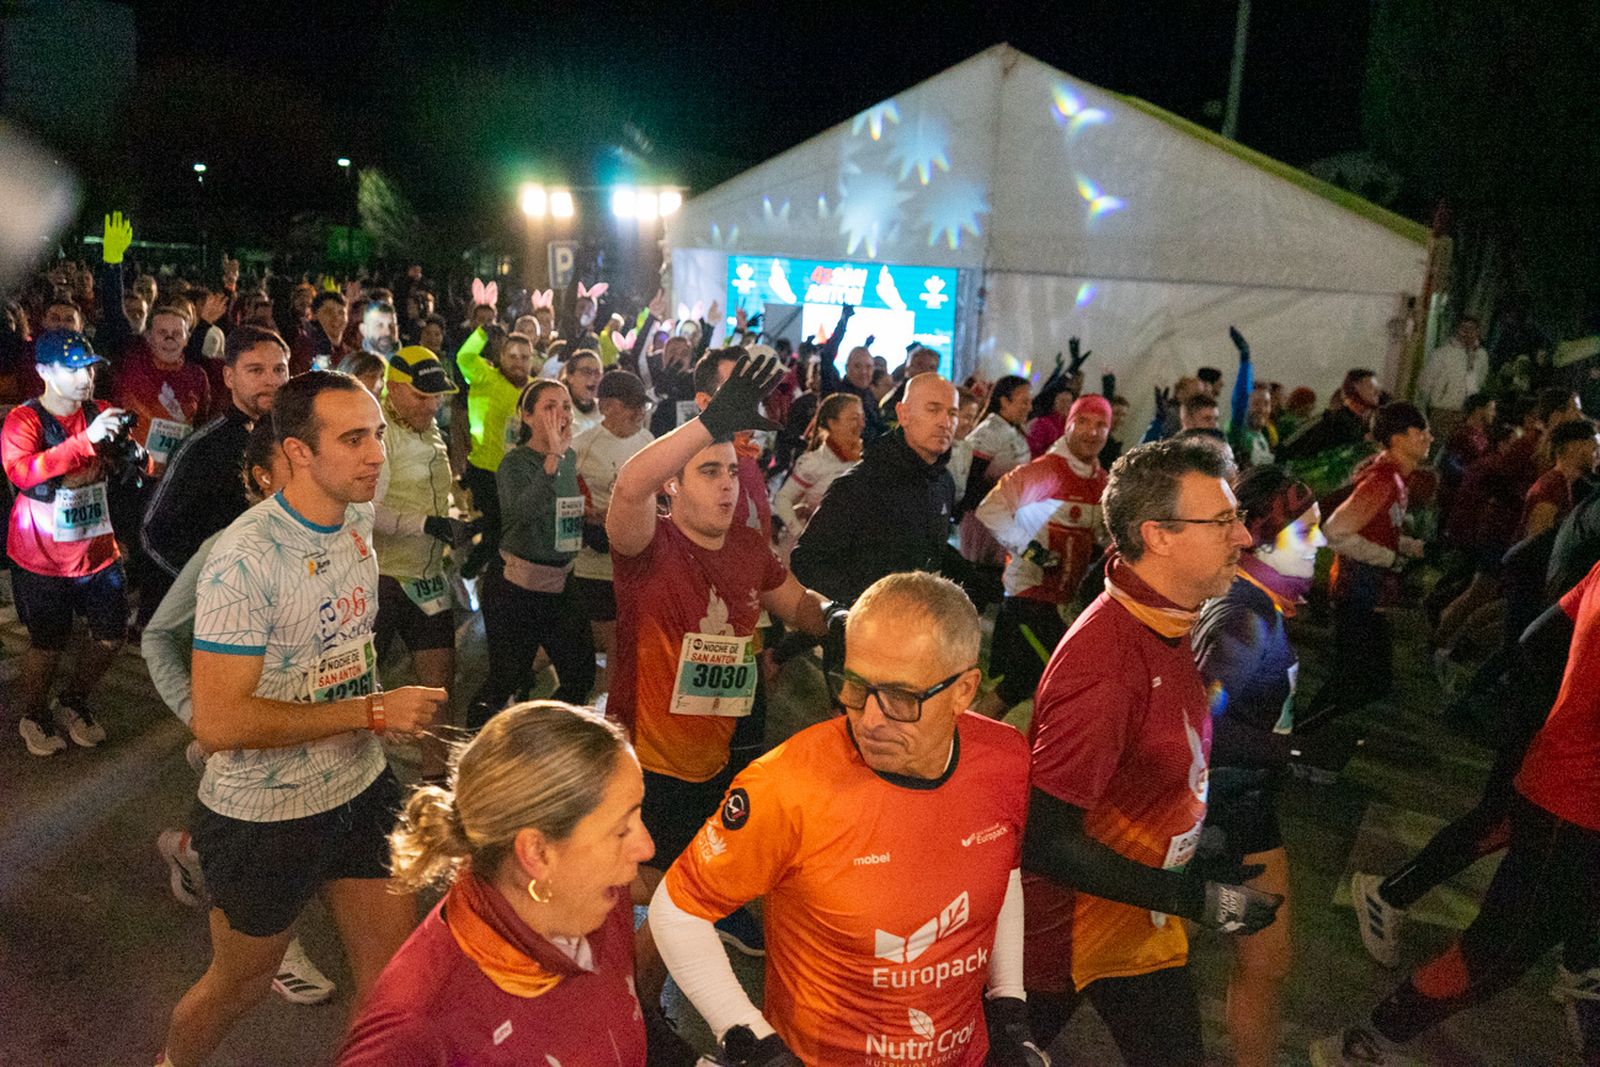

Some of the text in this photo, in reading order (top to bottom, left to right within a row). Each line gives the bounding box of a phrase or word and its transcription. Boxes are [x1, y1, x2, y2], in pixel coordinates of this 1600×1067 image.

[556, 247, 574, 283] P
[63, 502, 101, 524] 12076
[413, 575, 443, 598] 7929
[336, 586, 366, 625] 26
[690, 652, 709, 662] SAN
[704, 644, 728, 654] NOCHE
[729, 645, 739, 654] DE
[327, 654, 350, 671] NOCHE
[351, 651, 360, 662] DE
[318, 674, 338, 688] SAN
[693, 664, 748, 689] 3030
[853, 852, 890, 866] mobel
[872, 946, 988, 989] Europack
